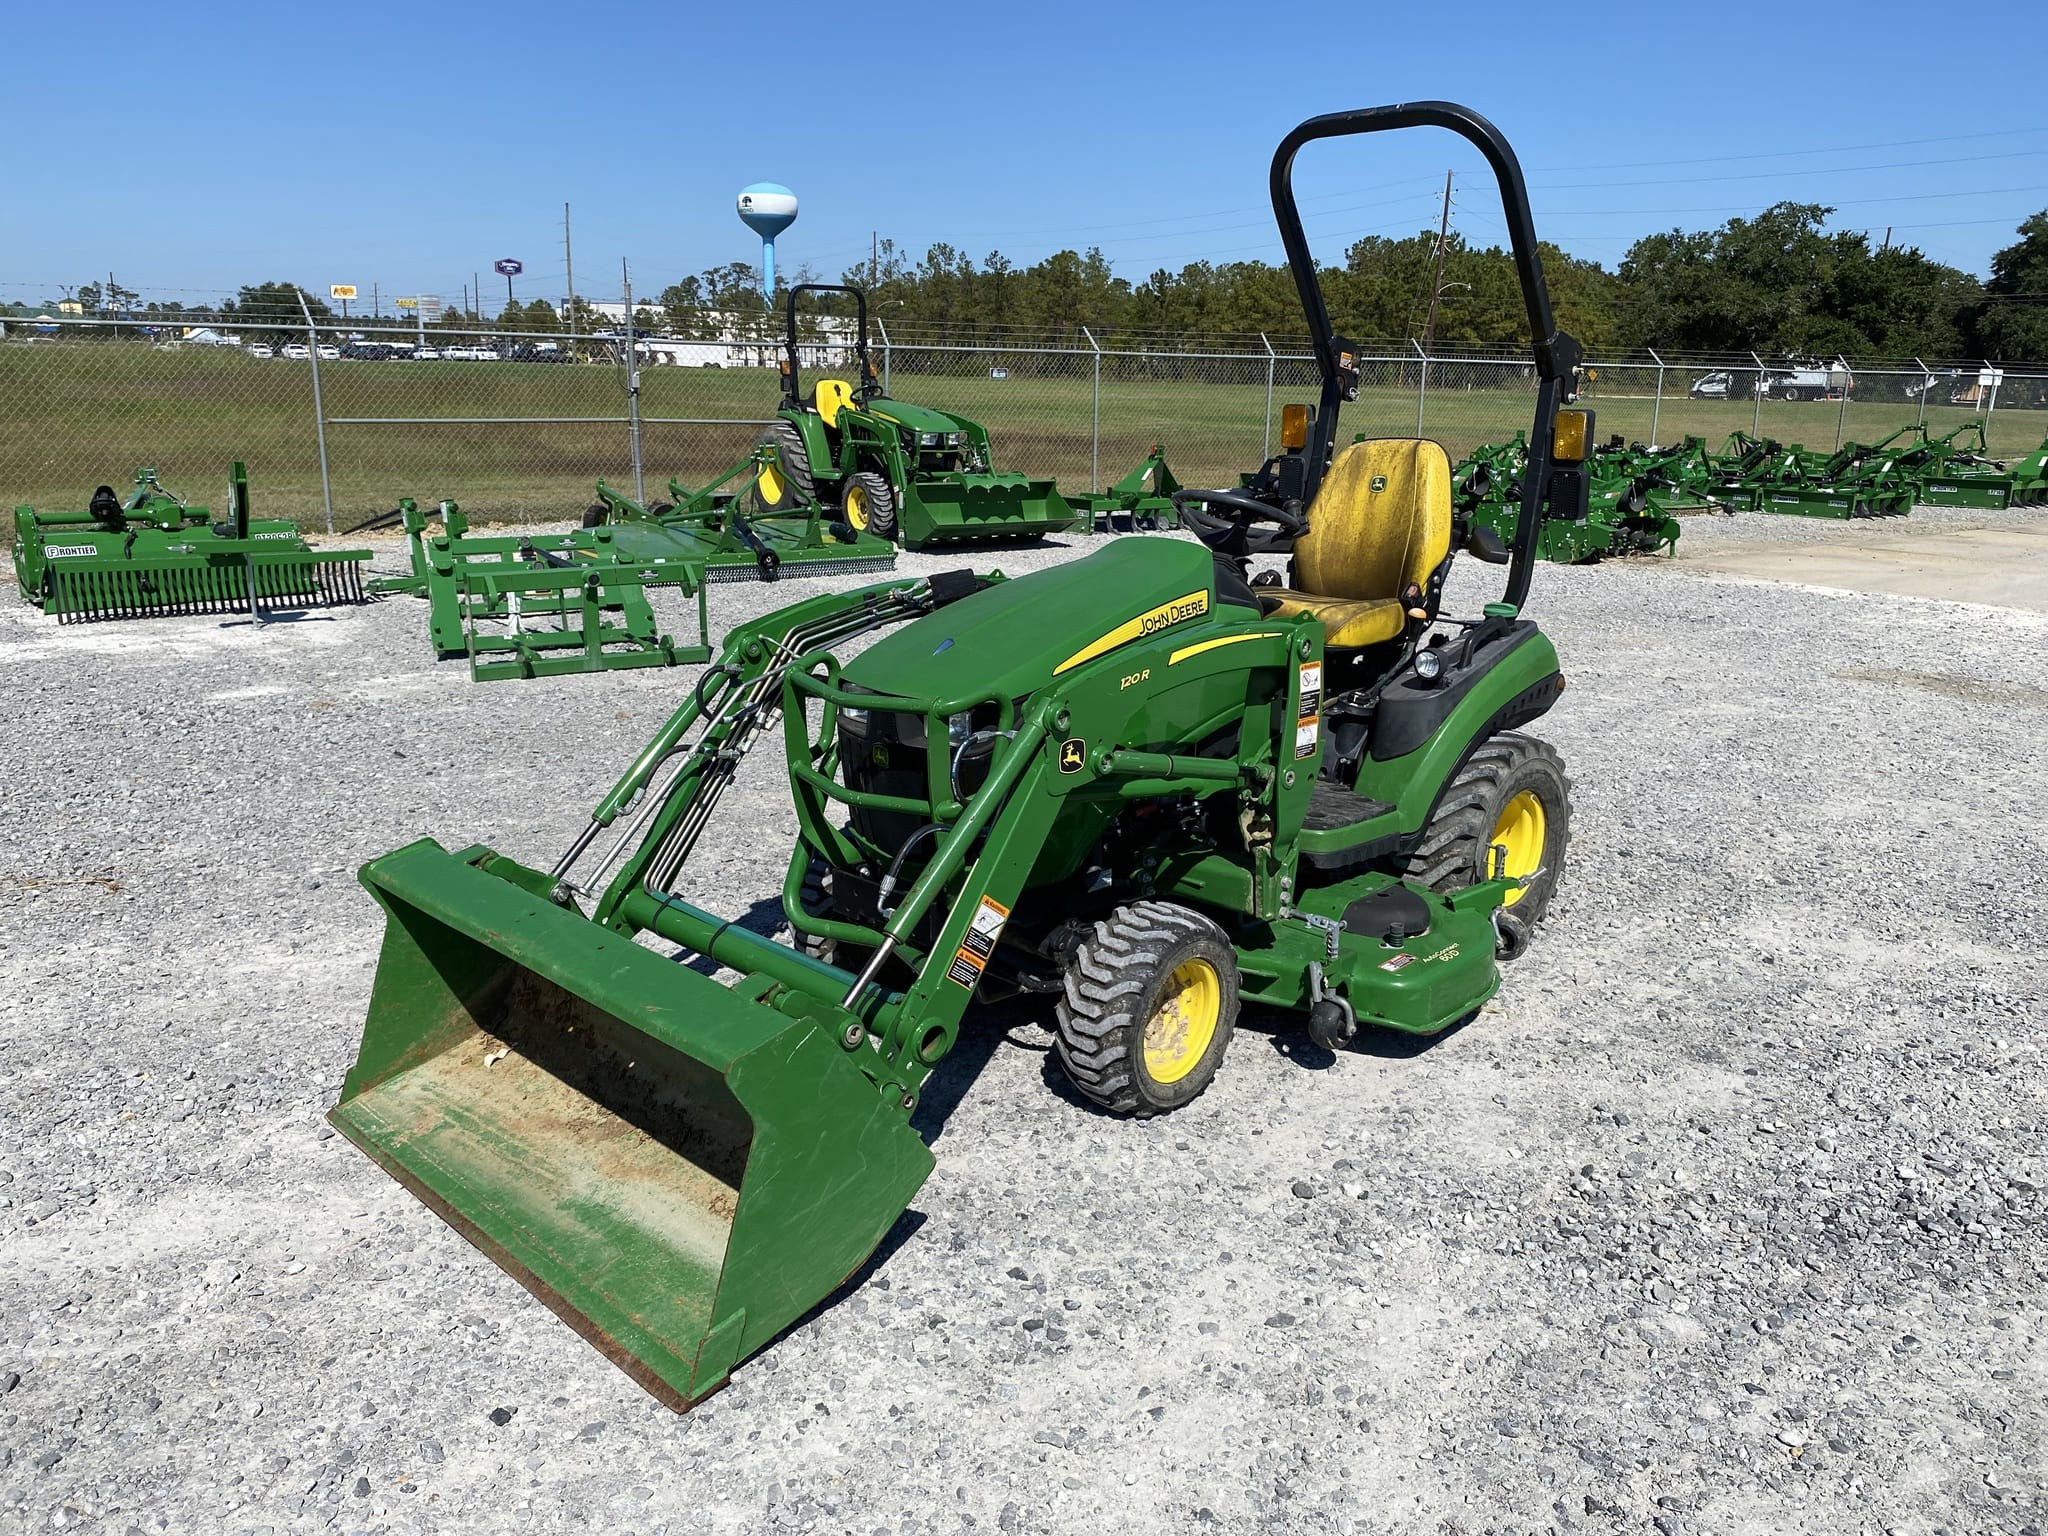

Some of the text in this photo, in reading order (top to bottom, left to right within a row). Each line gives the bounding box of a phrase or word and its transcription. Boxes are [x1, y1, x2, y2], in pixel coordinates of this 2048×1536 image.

[47, 546, 96, 557] FRONTIER
[1139, 599, 1205, 636] JOHN DEERE
